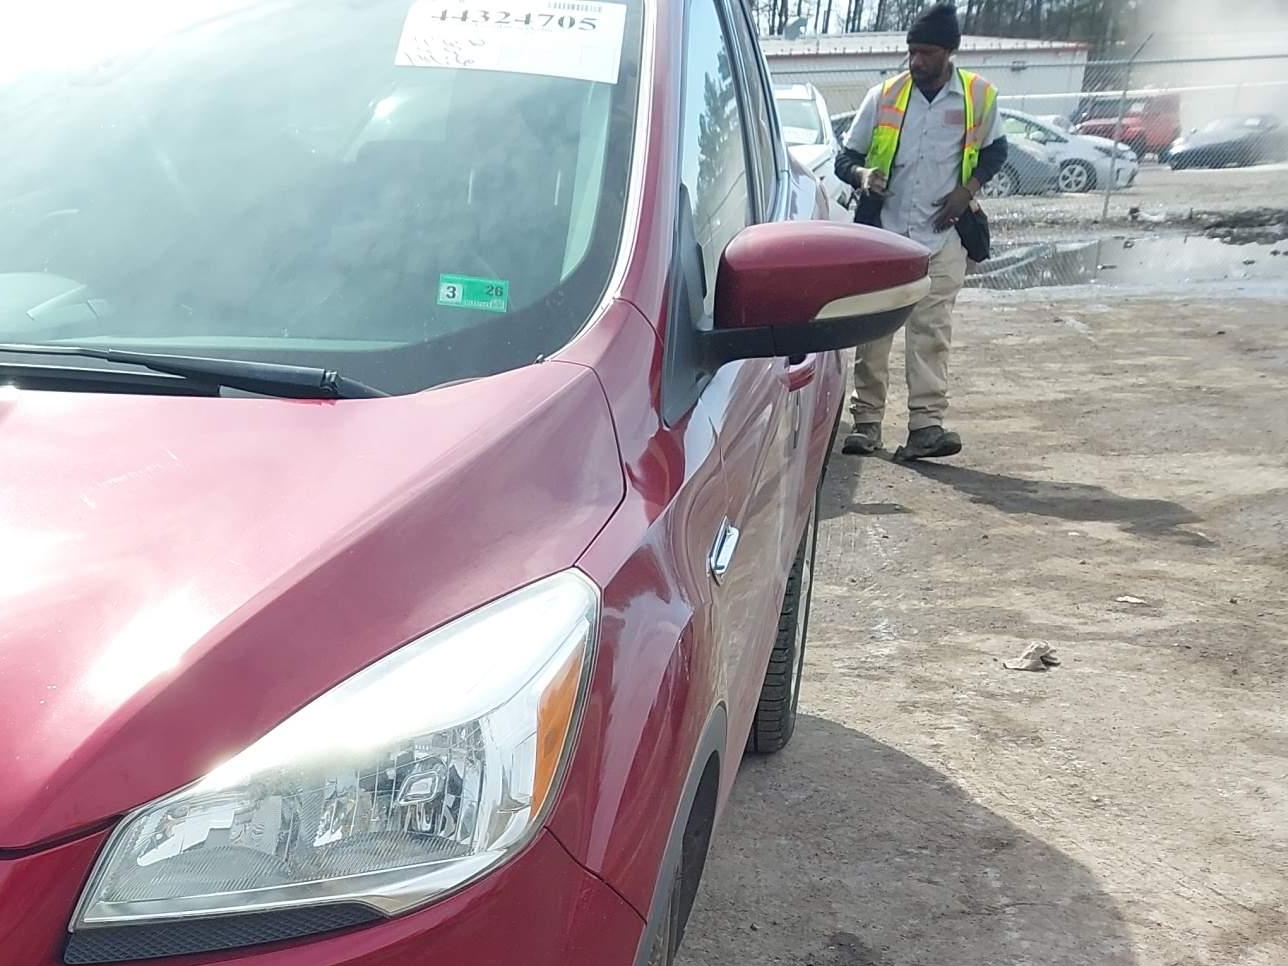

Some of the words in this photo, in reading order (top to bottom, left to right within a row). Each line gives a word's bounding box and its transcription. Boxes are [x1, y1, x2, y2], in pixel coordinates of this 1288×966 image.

[431, 9, 597, 31] 44324705
[445, 285, 457, 300] 3
[486, 284, 504, 297] 26
